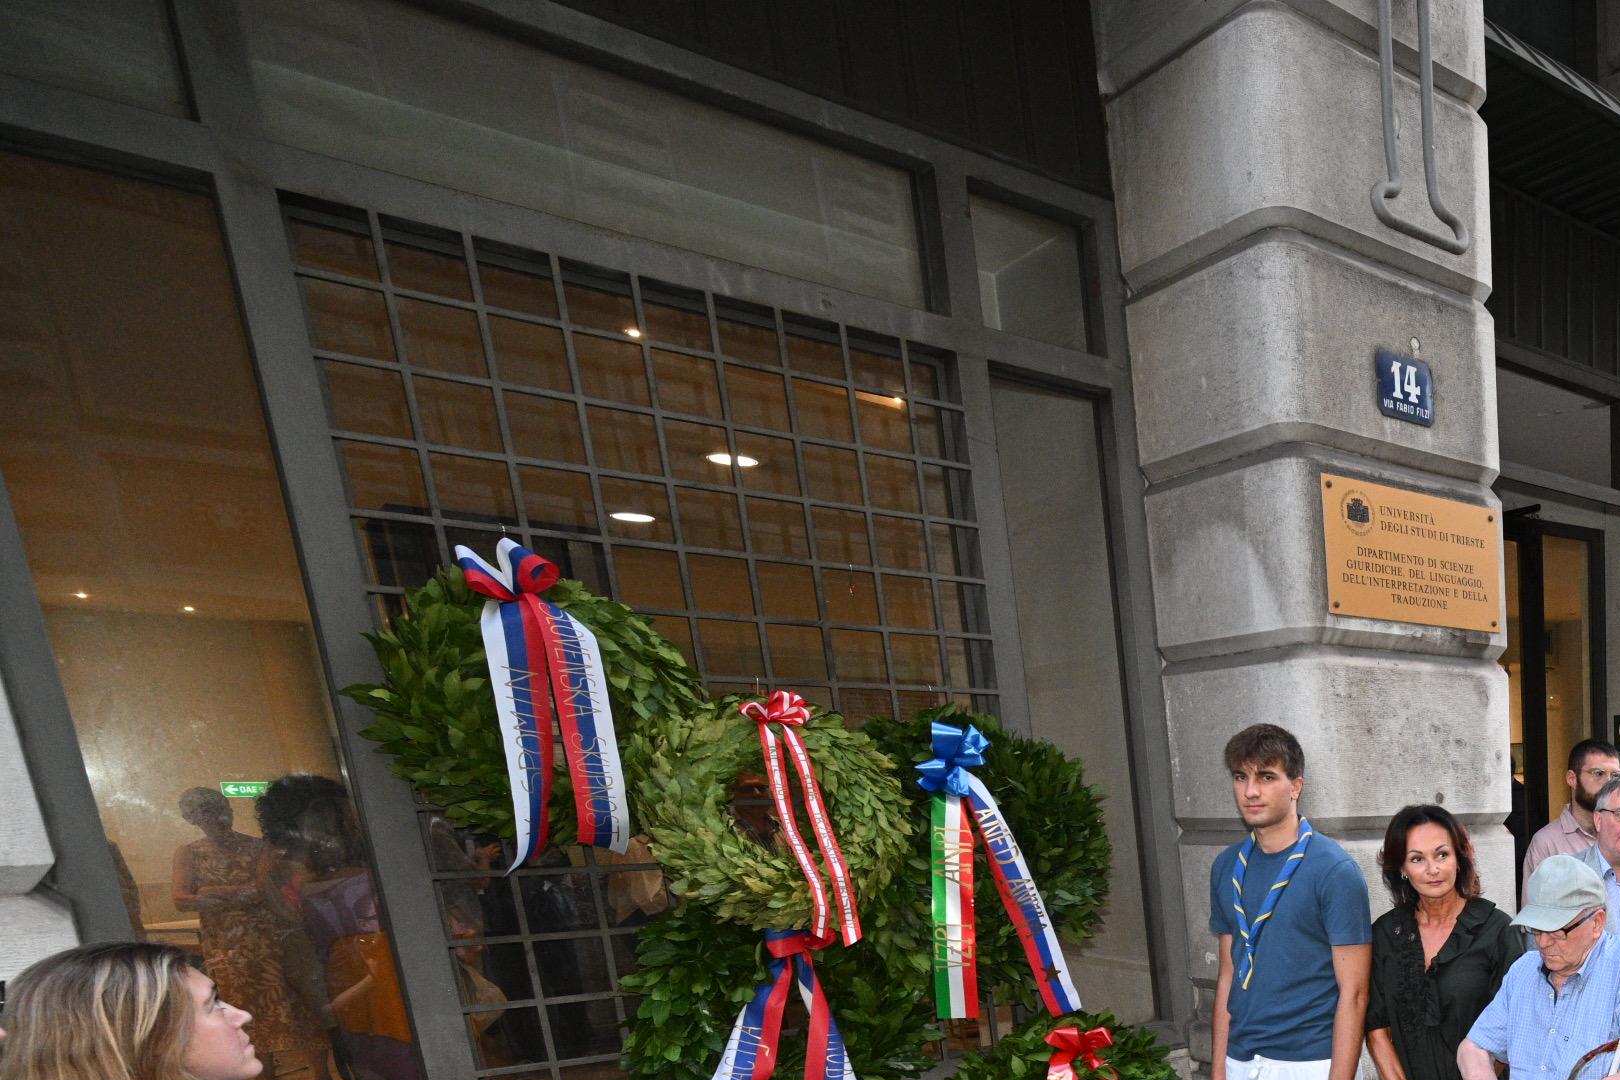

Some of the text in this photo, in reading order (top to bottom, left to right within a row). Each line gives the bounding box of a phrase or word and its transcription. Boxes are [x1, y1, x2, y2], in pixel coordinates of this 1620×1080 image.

[1391, 361, 1421, 404] 14
[1383, 398, 1430, 419] VIA FABIO FILZI
[1380, 505, 1435, 526] UNIVERSITÀ
[1381, 520, 1486, 550] DEGLI STUDI DI TRIESTE
[1356, 546, 1475, 575] DIPARTIMENTO DI SCIENZE
[1342, 572, 1489, 603] DELL'INTERPRETAZIONE E DELLA
[1409, 568, 1426, 581] DEL
[1429, 572, 1485, 590] LINGUAGGIO,
[1391, 593, 1449, 610] TRADUZIONE
[539, 601, 603, 719] SLOVENSKA
[501, 665, 546, 794] SPOMIN
[571, 732, 620, 843] SKUPNOST
[933, 825, 974, 972] VZPI ANPI
